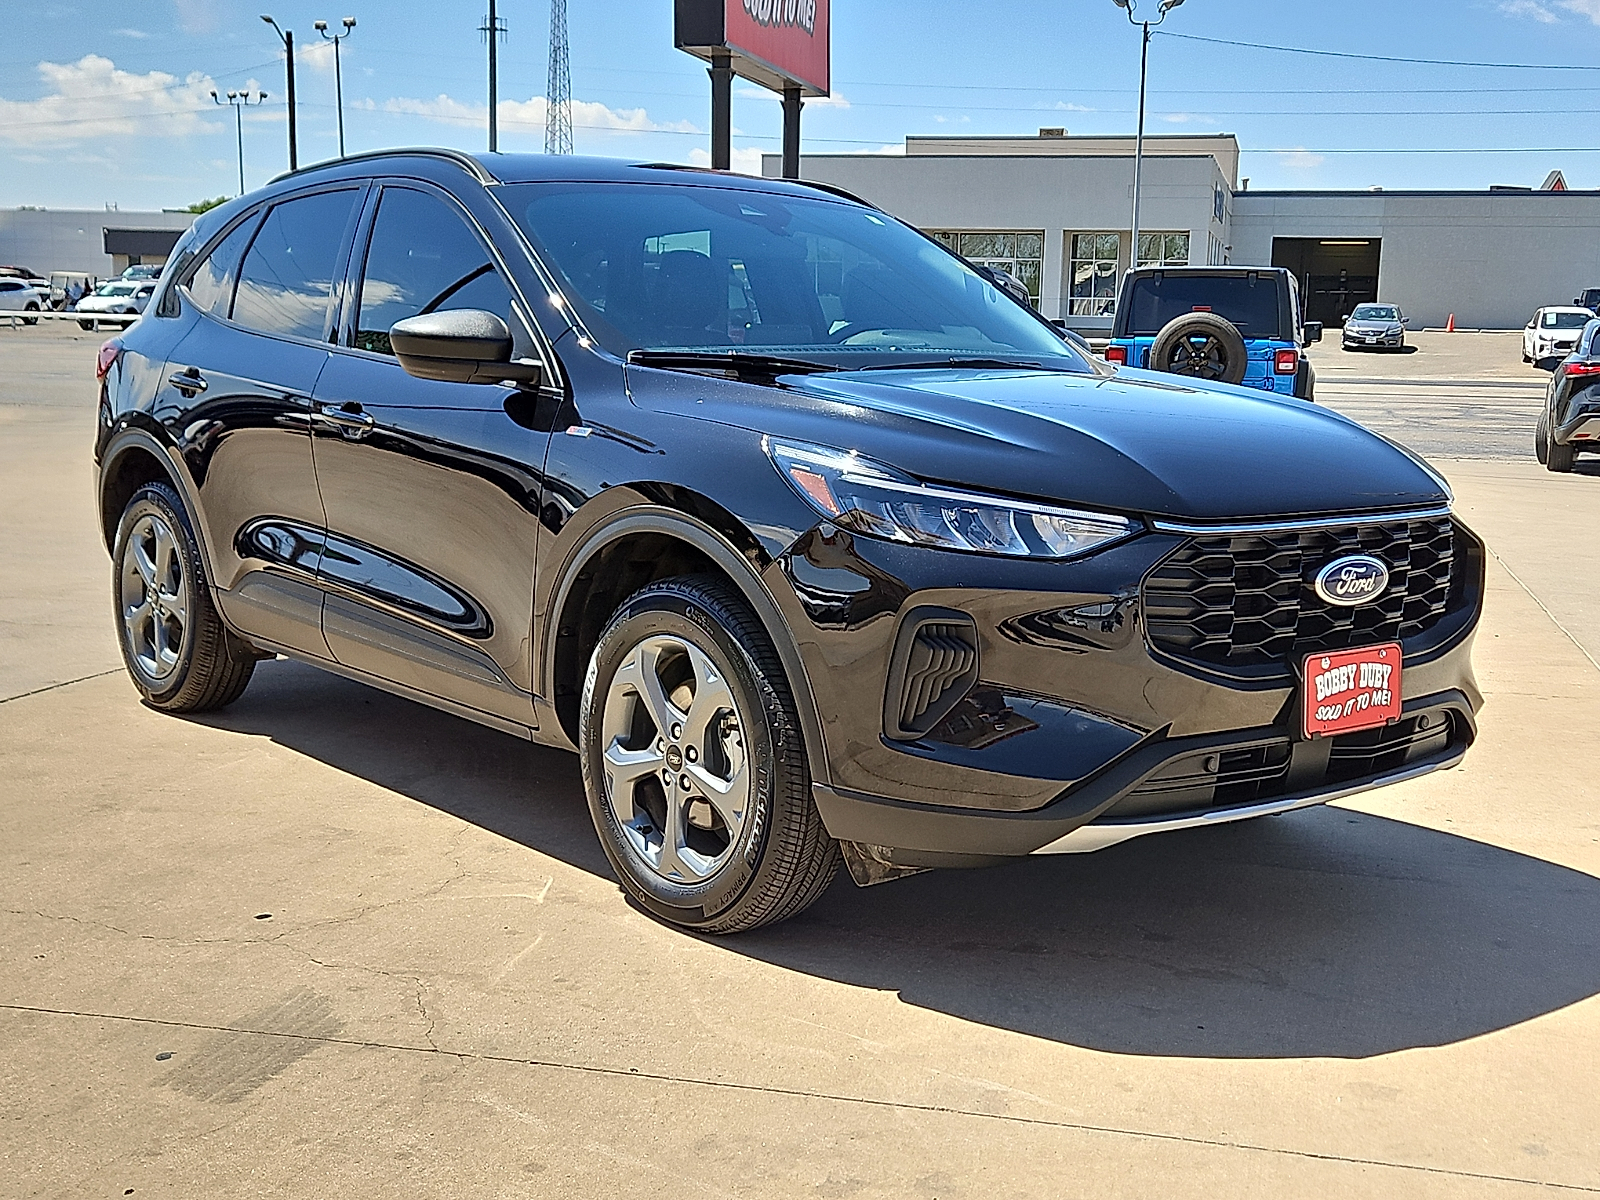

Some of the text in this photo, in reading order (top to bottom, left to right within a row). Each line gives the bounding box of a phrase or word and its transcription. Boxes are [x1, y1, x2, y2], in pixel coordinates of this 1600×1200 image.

[743, 0, 771, 24] LD
[1336, 566, 1376, 595] Ford
[1315, 662, 1392, 702] BOBBY DUBY
[1315, 689, 1392, 721] SOLD IT TO ME!
[718, 871, 748, 907] PRIMACY
